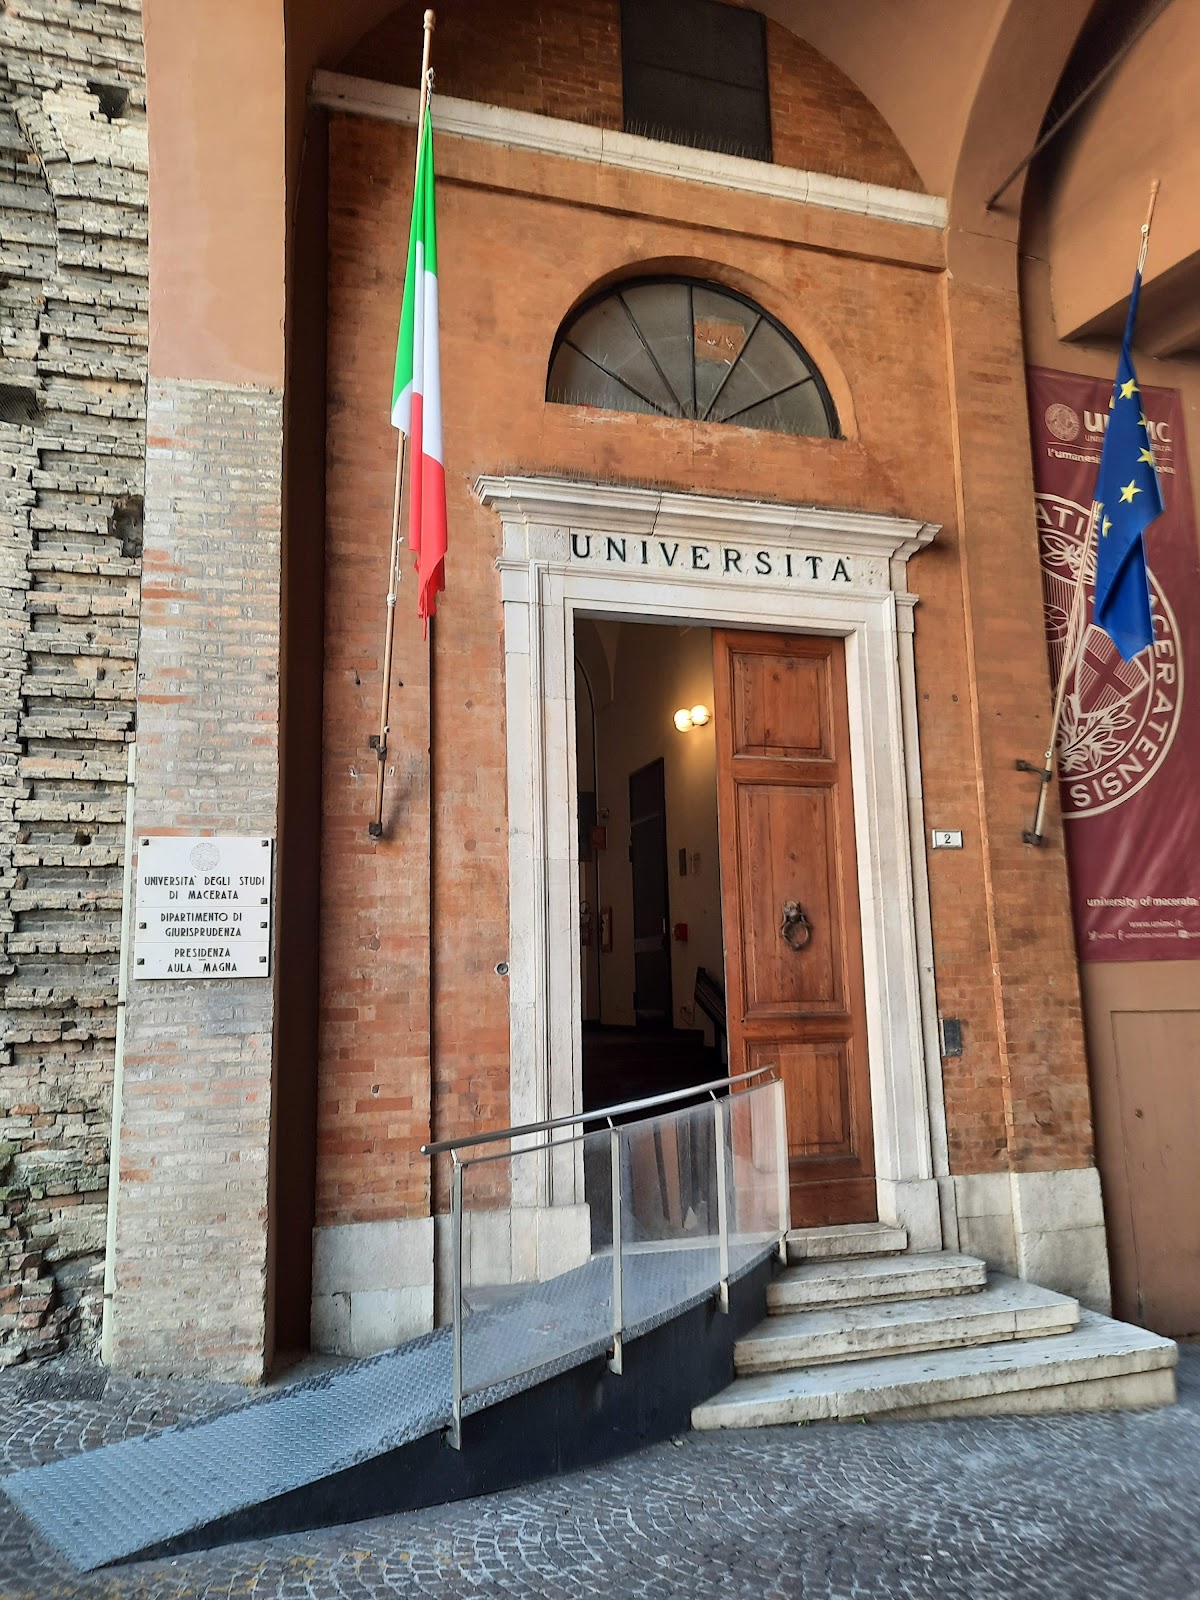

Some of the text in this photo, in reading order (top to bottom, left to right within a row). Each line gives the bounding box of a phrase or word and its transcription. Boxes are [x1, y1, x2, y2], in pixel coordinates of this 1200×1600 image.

[944, 833, 952, 844] 2
[204, 877, 230, 885] DEGLI
[240, 877, 264, 885] STUDI
[169, 890, 238, 899] DI MACERATA
[1086, 895, 1199, 909] university of macerata
[161, 913, 242, 922] DIPARTIMENTO DI
[165, 928, 241, 937] GIURISPRUDENZA
[175, 948, 230, 957] PRESIDENZA
[167, 963, 237, 972] AULA MAGNA
